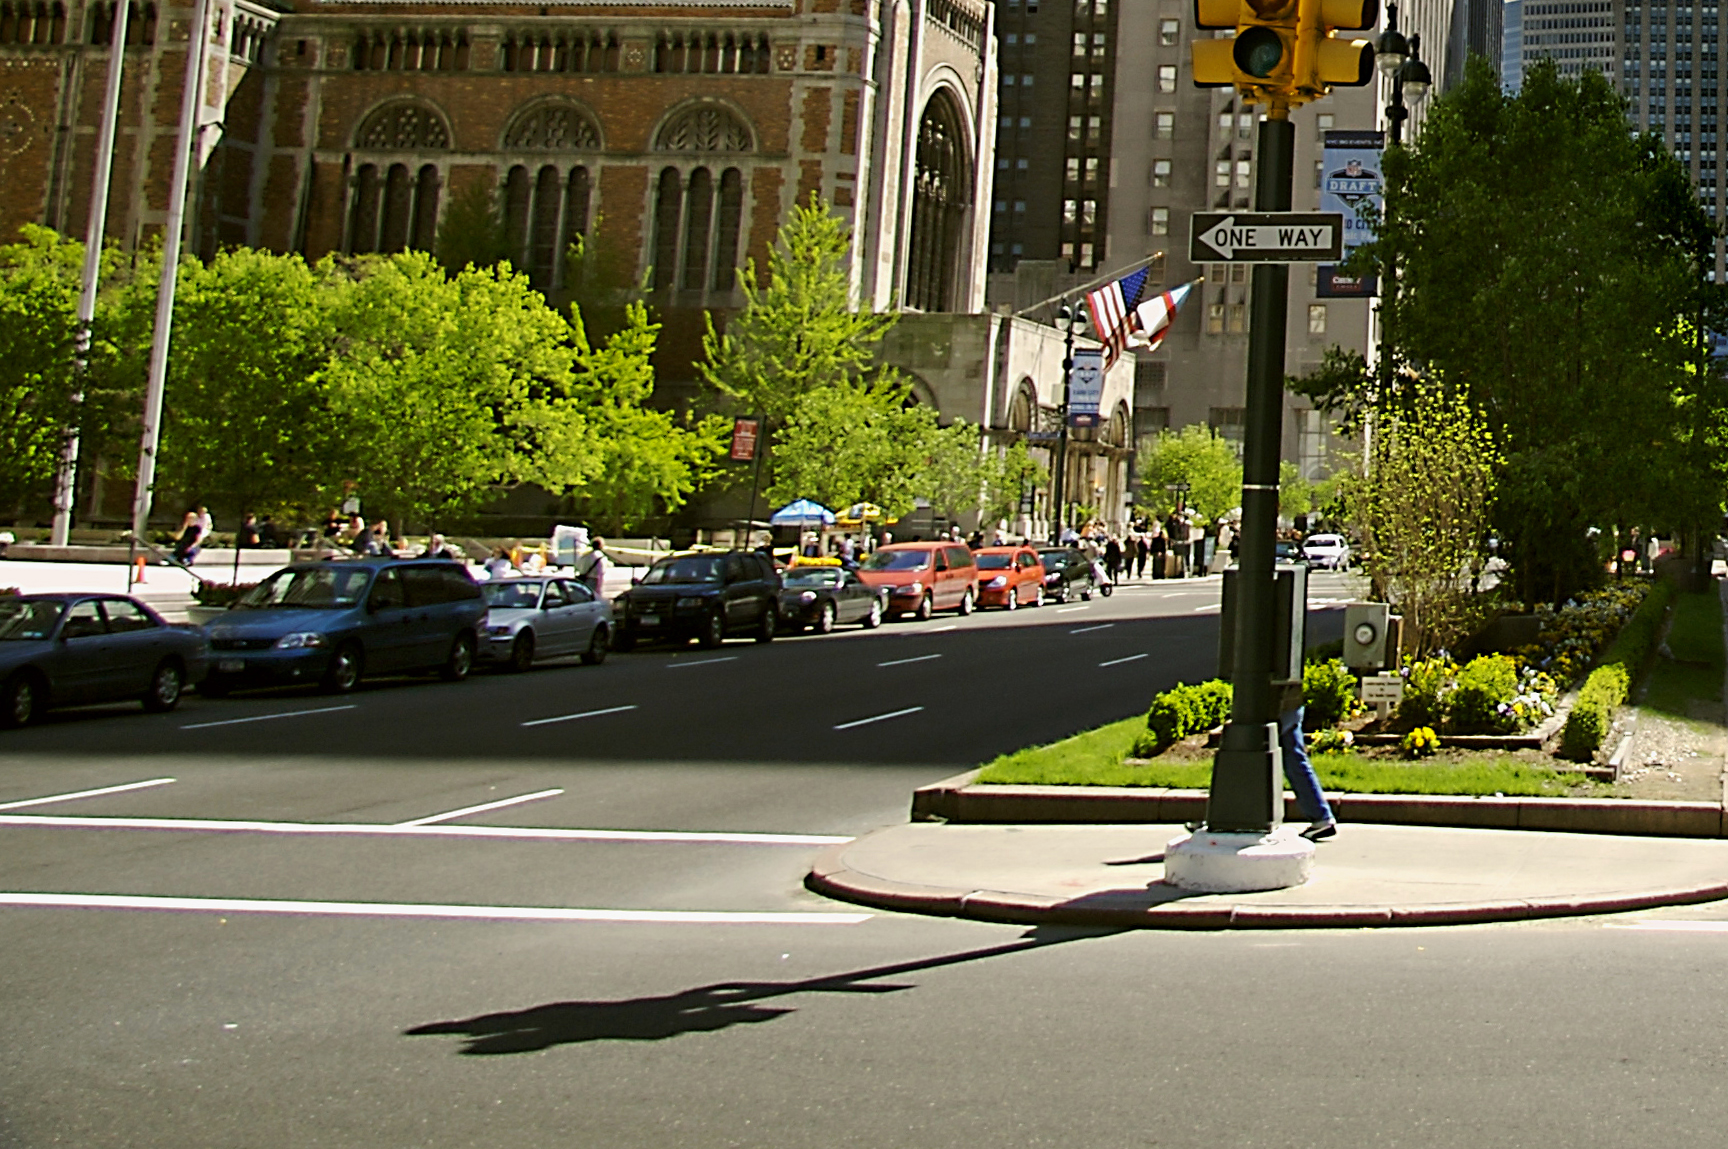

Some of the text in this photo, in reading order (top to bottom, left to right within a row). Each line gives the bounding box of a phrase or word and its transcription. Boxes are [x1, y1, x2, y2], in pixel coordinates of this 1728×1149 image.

[1330, 181, 1377, 191] DRAFT
[1214, 228, 1257, 247] ONE
[1278, 228, 1323, 247] WAY
